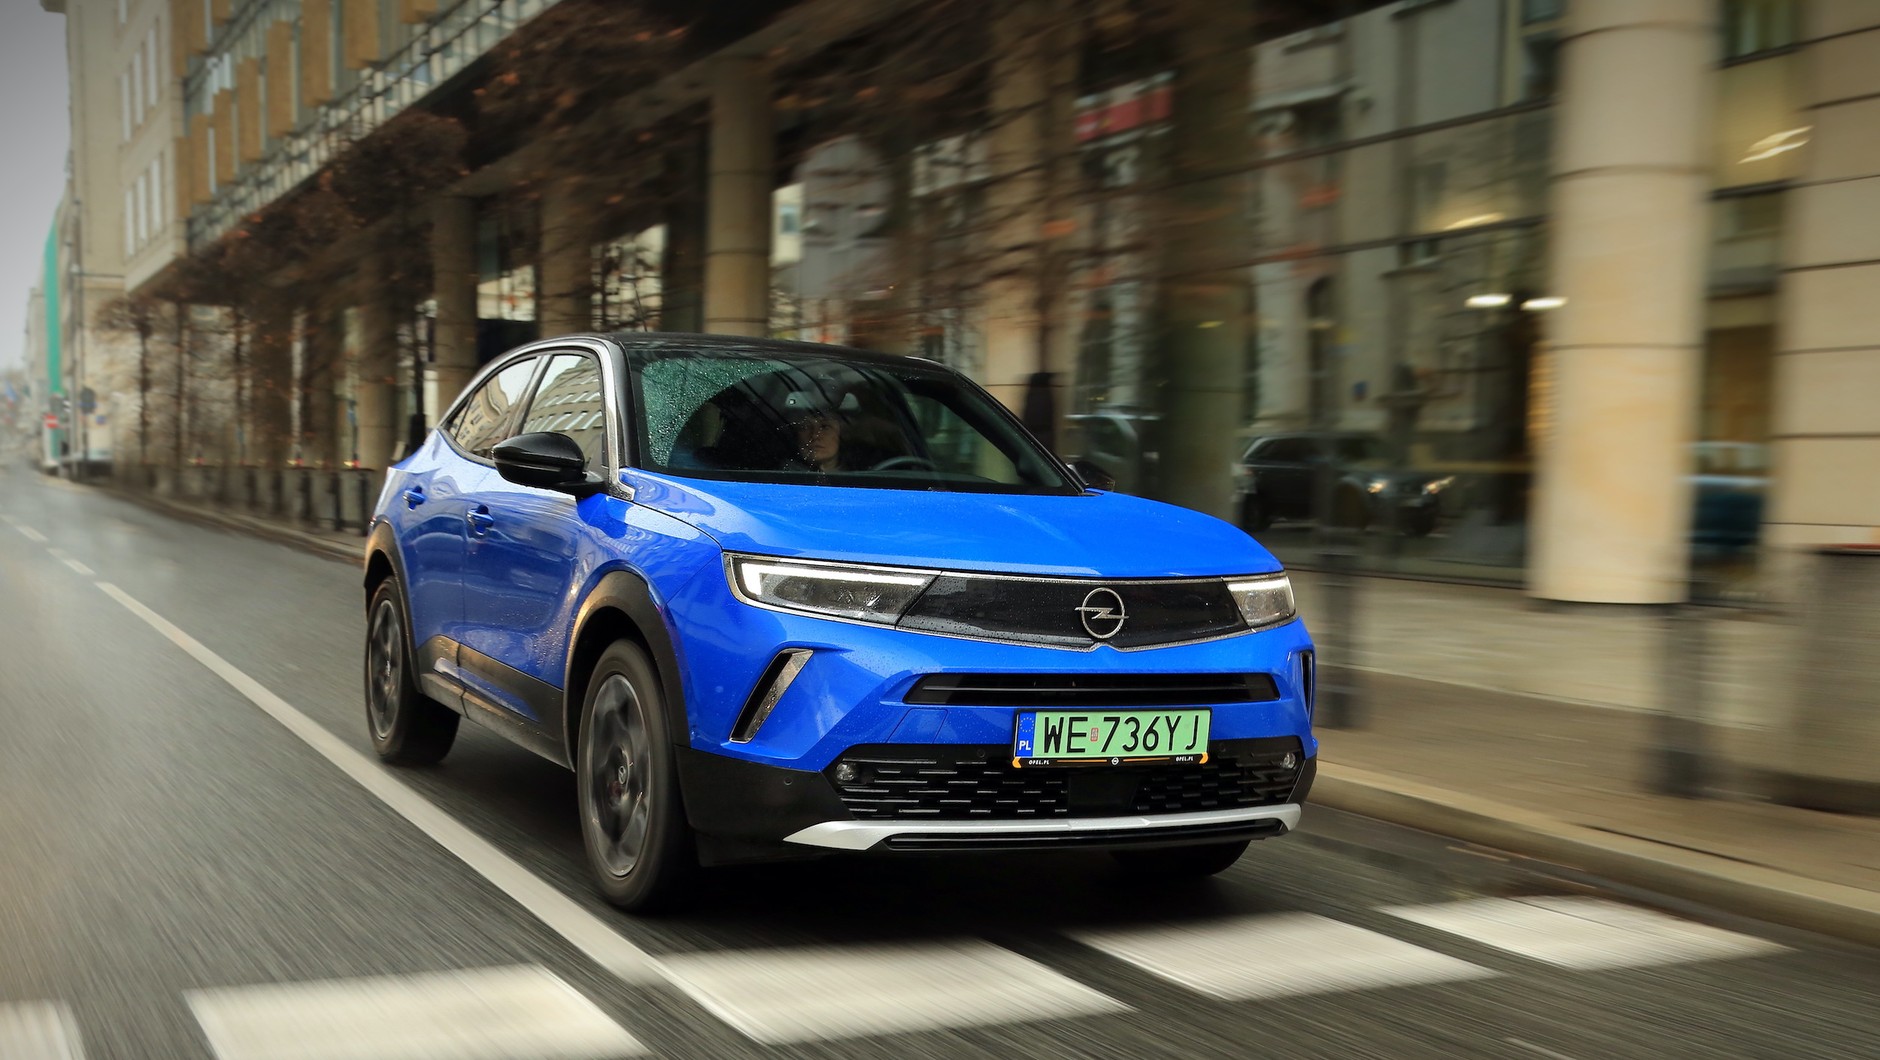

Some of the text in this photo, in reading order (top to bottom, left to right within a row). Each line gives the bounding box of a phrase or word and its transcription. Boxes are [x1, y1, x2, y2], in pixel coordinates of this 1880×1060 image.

[1019, 740, 1032, 751] PL
[1043, 714, 1200, 754] WE 736YJ
